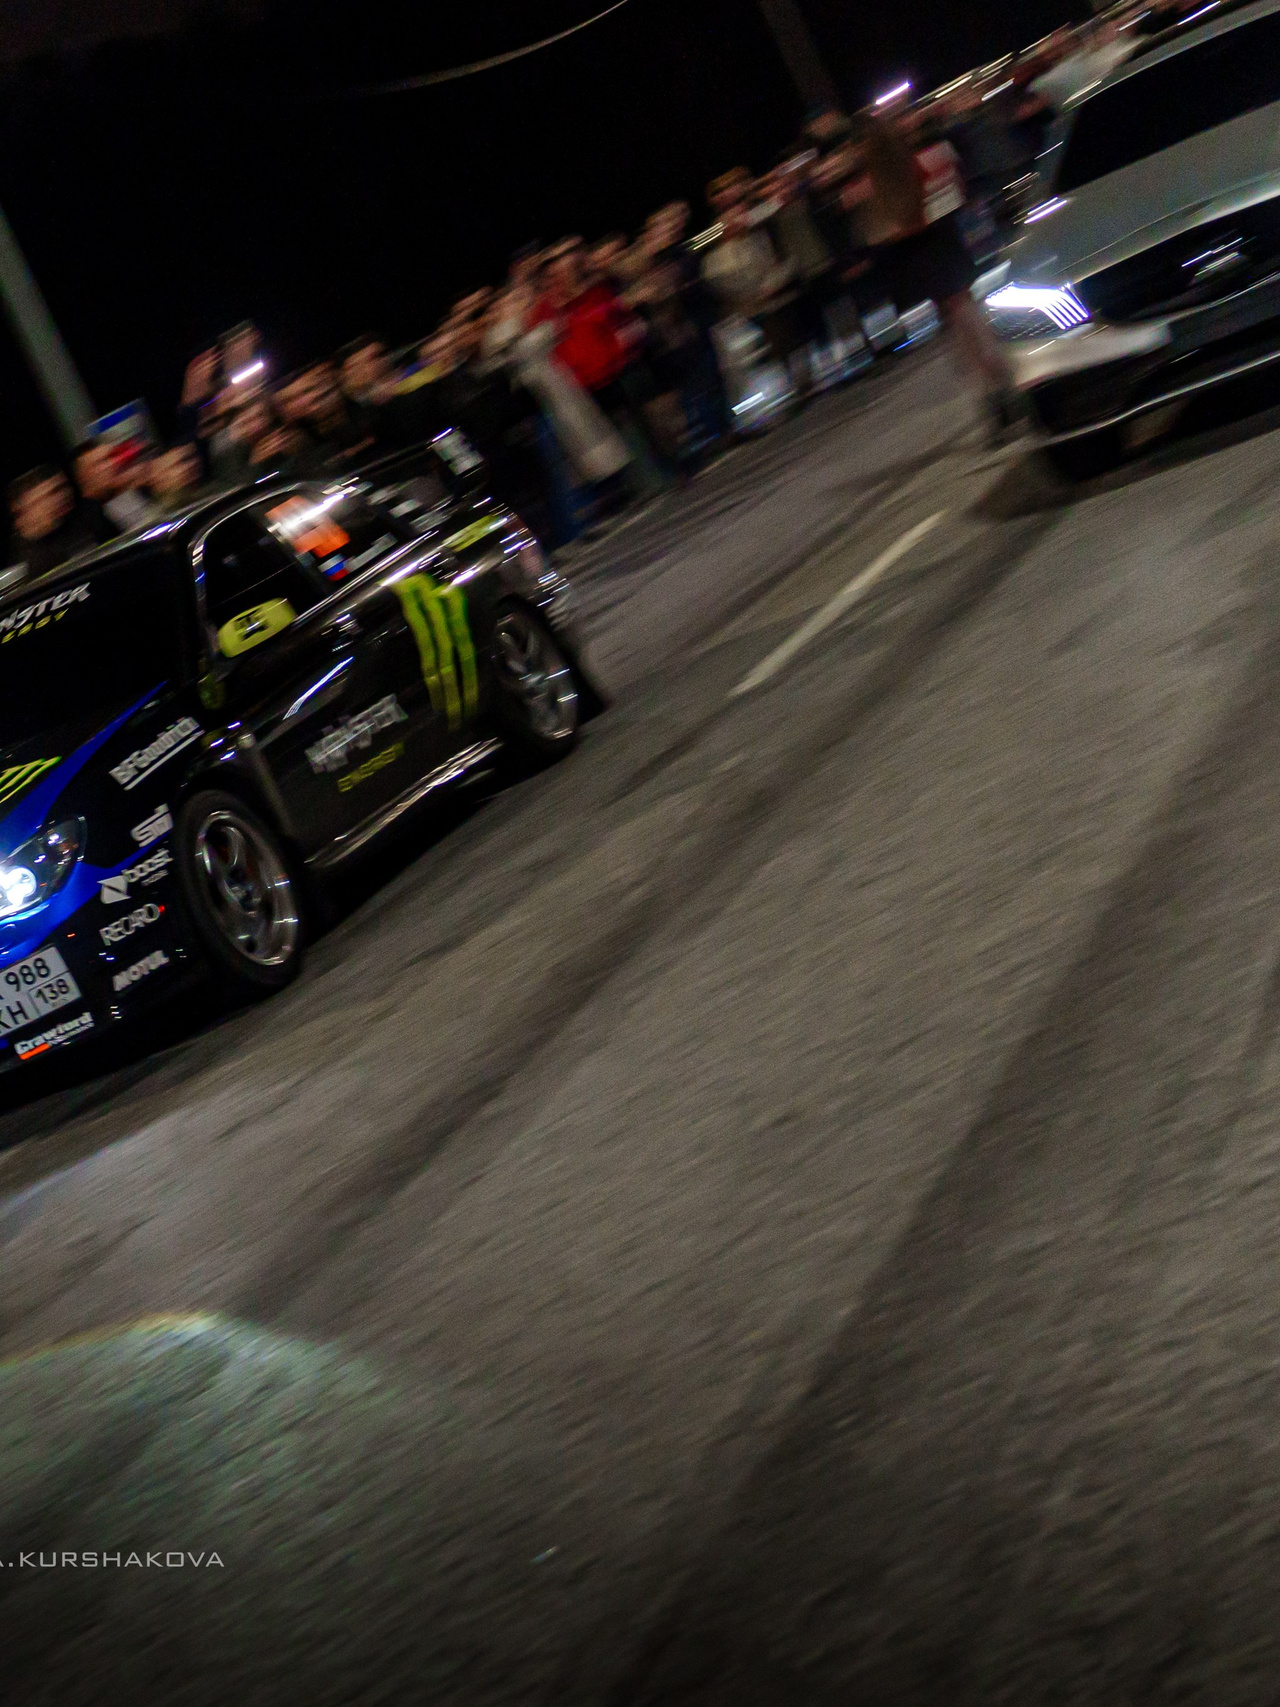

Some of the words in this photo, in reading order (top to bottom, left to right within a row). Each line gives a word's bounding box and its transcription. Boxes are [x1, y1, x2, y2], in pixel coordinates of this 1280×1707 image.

[99, 903, 161, 947] RECARO
[5, 957, 51, 992] 988
[35, 978, 70, 1004] 138
